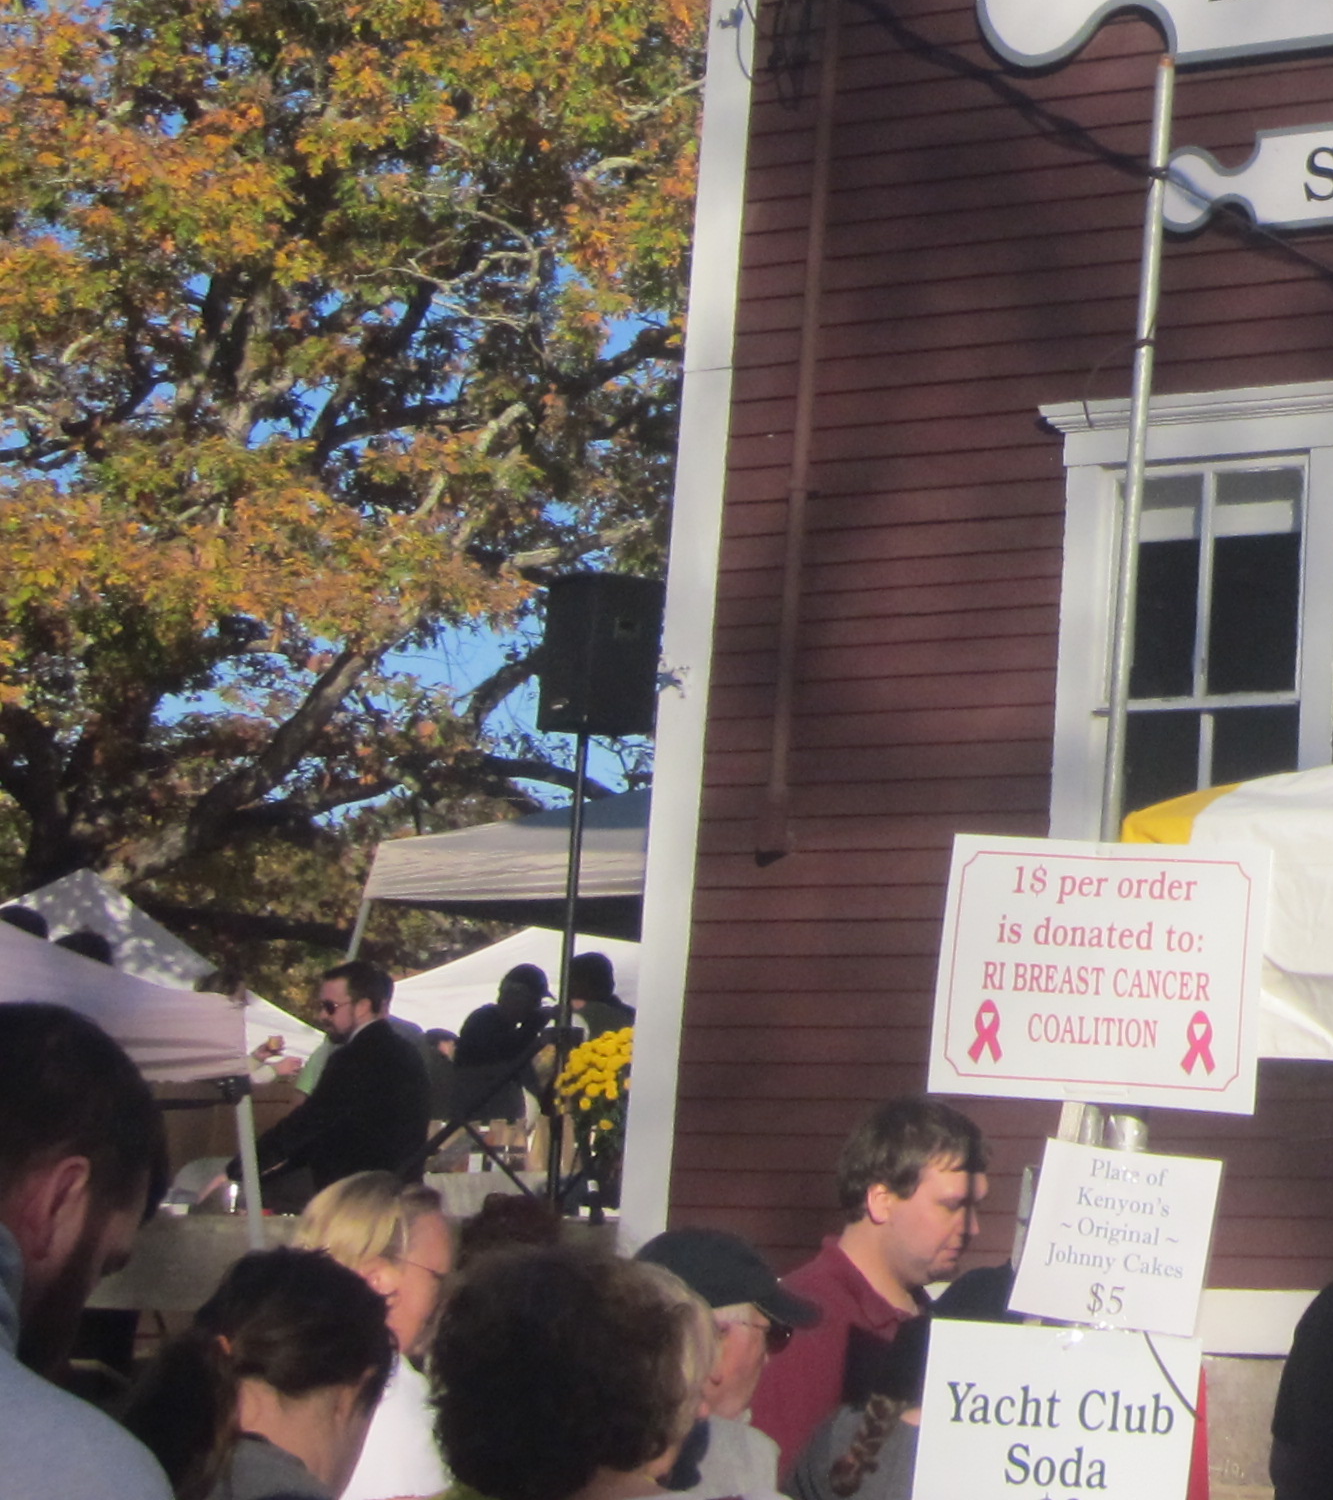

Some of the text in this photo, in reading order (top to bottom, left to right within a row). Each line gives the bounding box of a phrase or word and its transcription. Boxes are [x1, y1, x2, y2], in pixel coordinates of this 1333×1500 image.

[1012, 864, 1198, 904] 1$ per order
[996, 914, 1205, 953] is donated to:
[981, 961, 1211, 1001] RI BREAST CANCER
[1027, 1013, 1159, 1048] COALITION
[1090, 1158, 1169, 1187] Plate of
[1076, 1186, 1171, 1217] Kenyon's
[1045, 1242, 1184, 1279] Johnny Cakes
[1086, 1282, 1126, 1316] $5
[946, 1381, 1175, 1435] Yacht Club
[1004, 1442, 1108, 1489] Soda
